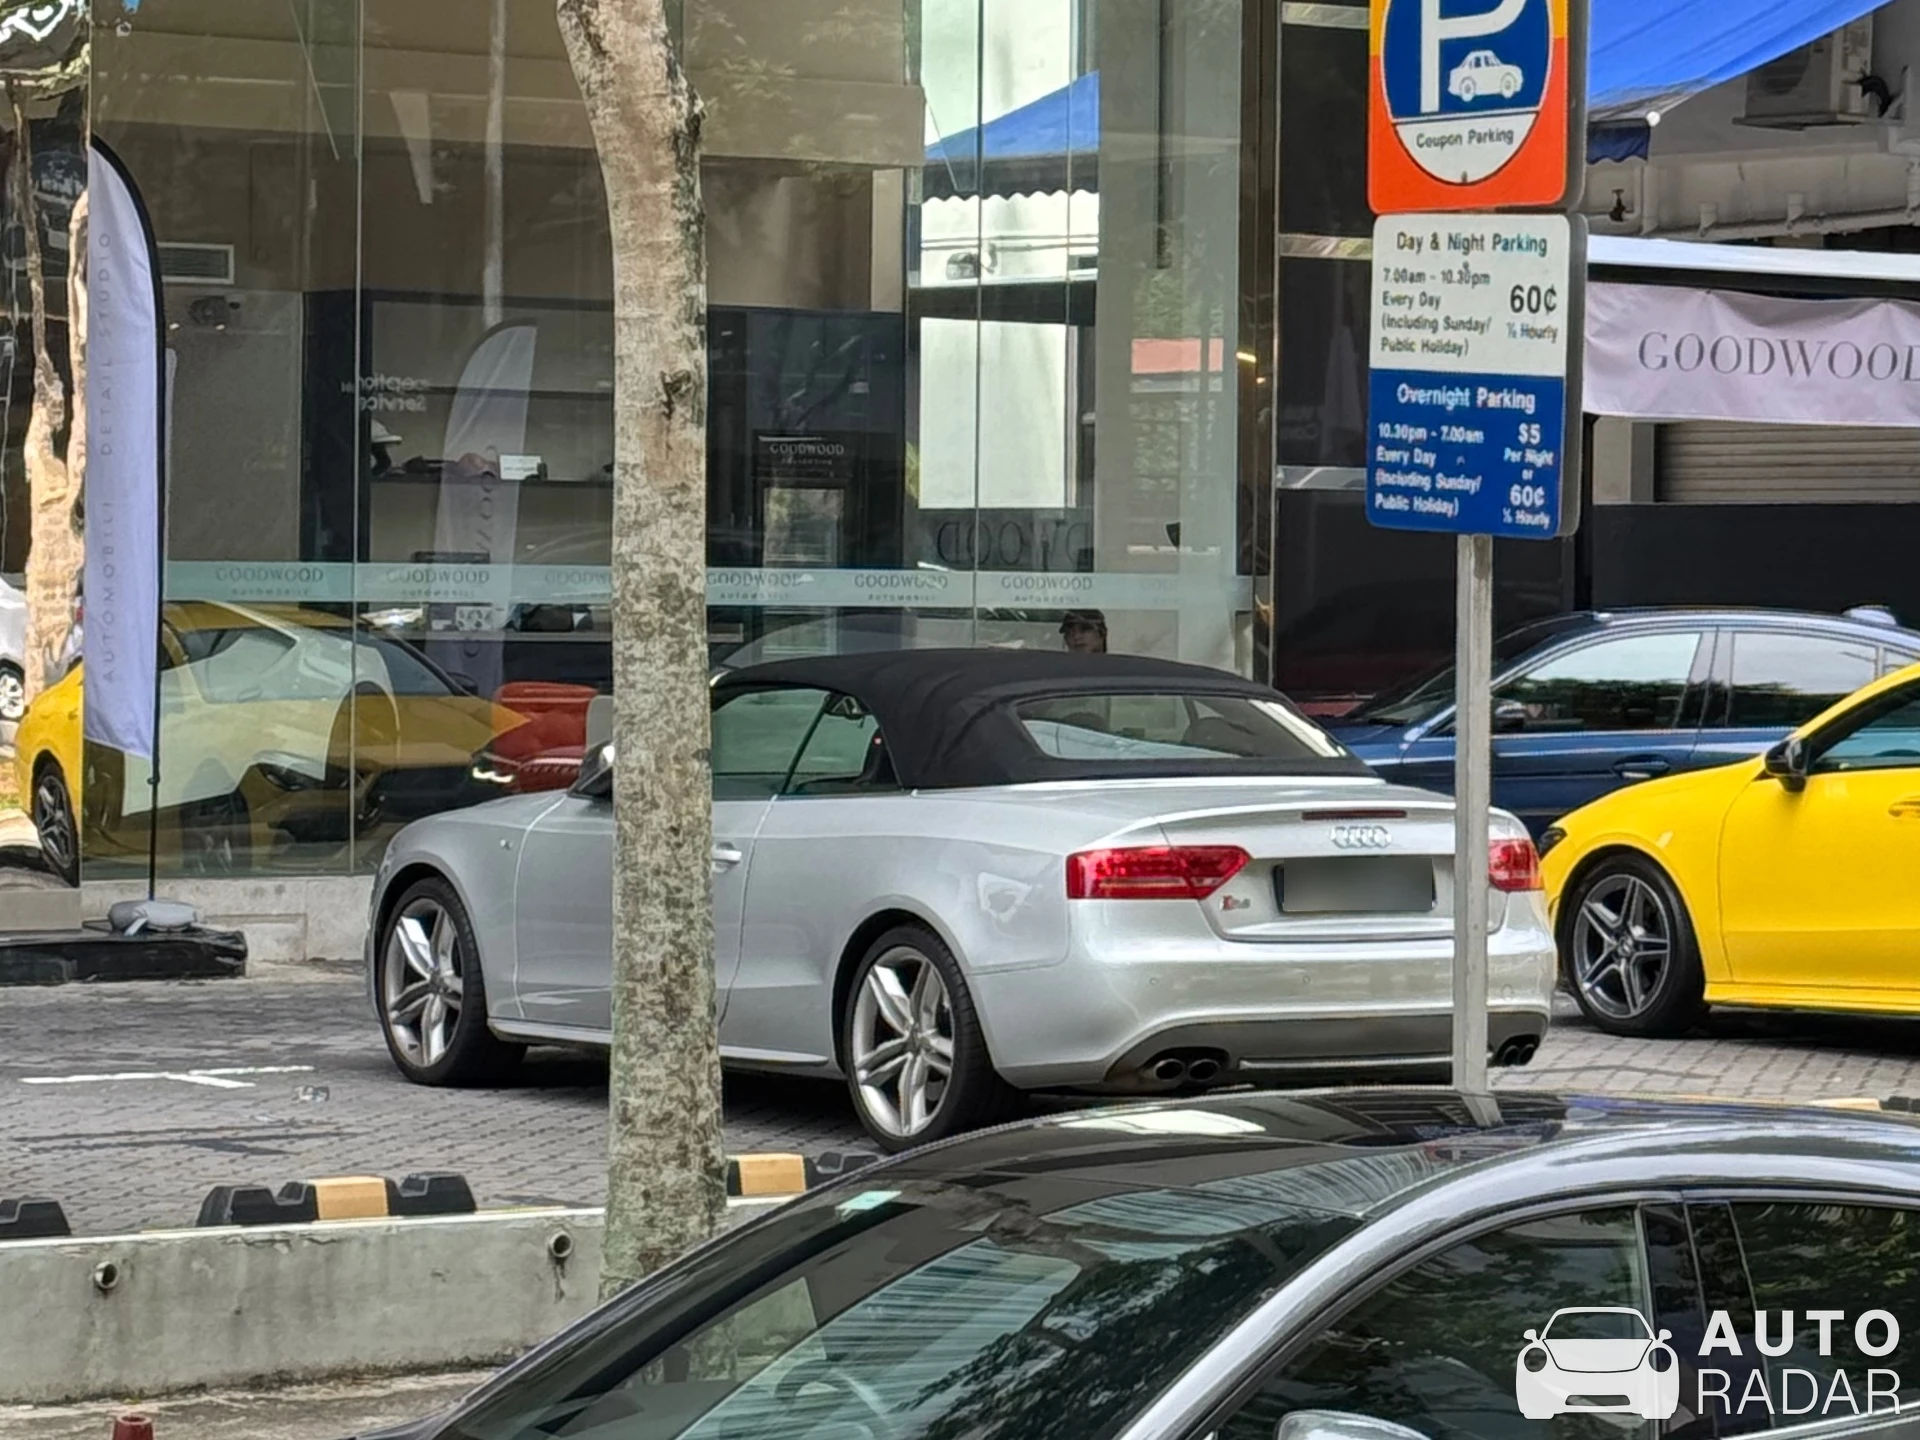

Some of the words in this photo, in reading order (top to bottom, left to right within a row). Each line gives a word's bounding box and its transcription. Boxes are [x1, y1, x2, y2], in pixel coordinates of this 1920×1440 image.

[1416, 133, 1463, 150] Coupon
[1467, 129, 1514, 145] Parking
[1396, 232, 1423, 255] Day
[1430, 232, 1440, 250] &
[1447, 233, 1485, 256] Night
[1492, 234, 1548, 257] Parking
[98, 233, 112, 338] STUDIO
[1383, 267, 1426, 284] 7.00am
[1440, 268, 1491, 289] 10.30pm
[1382, 290, 1415, 310] Every
[1419, 291, 1441, 311] Day
[1510, 283, 1557, 316] 60¢
[1382, 312, 1439, 334] (Including
[1520, 322, 1558, 344] Hourly
[1380, 336, 1417, 353] Public
[1421, 338, 1469, 358] Holiday)
[1638, 331, 1920, 382] GOODWOOD
[101, 359, 113, 456] DETAIL
[1397, 383, 1470, 411] Overnight
[1476, 386, 1536, 414] Parking
[1378, 422, 1428, 444] 10.30pm
[1440, 425, 1484, 444] 7.00am
[1376, 445, 1410, 466] Every
[1413, 447, 1437, 469] Day
[1503, 447, 1522, 463] Per
[1525, 448, 1554, 468] Night
[1522, 468, 1534, 481] or
[1375, 492, 1410, 512] Public
[1413, 496, 1459, 518] Holiday)
[1510, 484, 1545, 507] 60¢
[1515, 509, 1551, 530] Hourly
[215, 567, 324, 582] GOODWOOD
[1000, 575, 1093, 590] GOODWOOD
